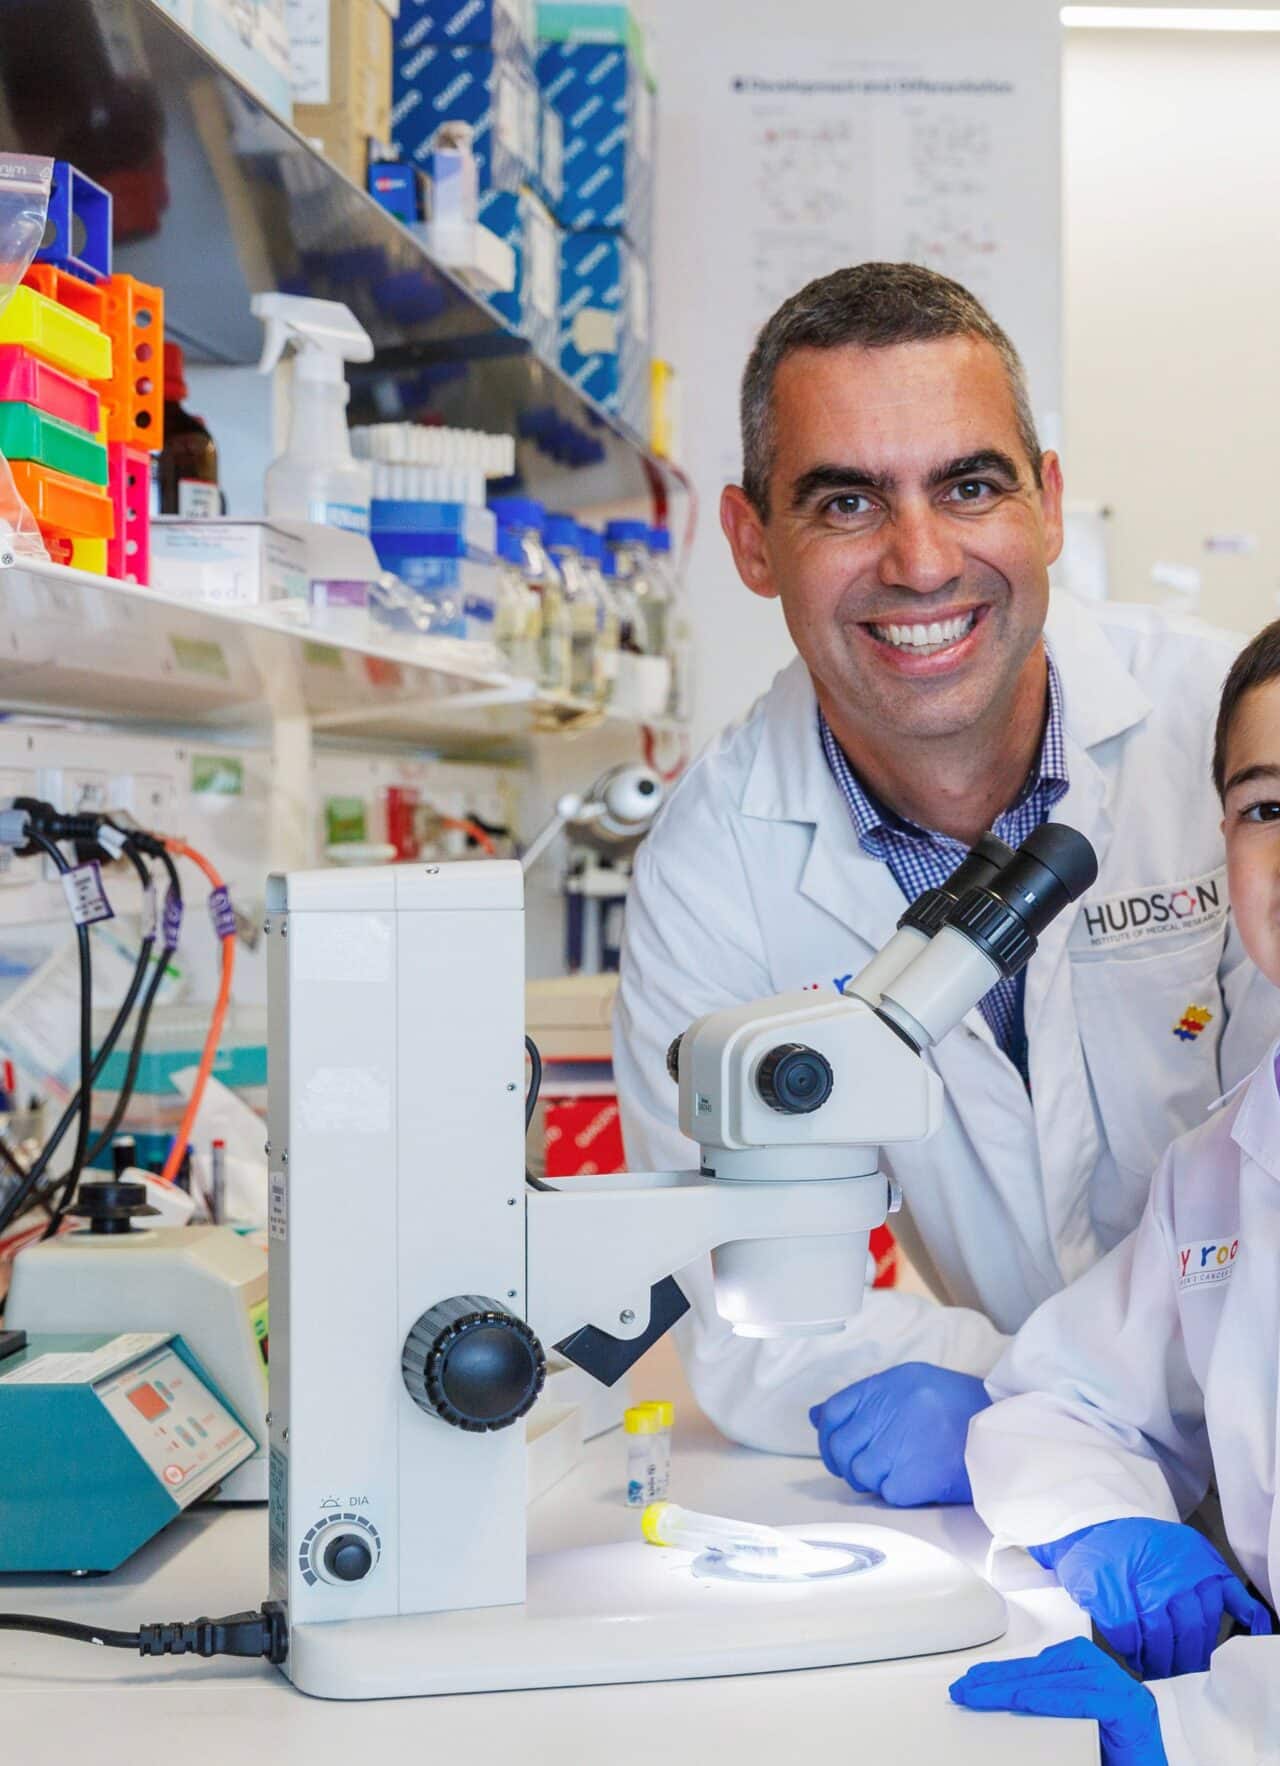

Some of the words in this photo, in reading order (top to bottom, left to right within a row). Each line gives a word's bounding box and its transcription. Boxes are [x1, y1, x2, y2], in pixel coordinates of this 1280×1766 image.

[1084, 880, 1219, 936] HUDSON
[1146, 922, 1180, 935] MEDICAL
[1201, 1239, 1239, 1267] roo
[349, 1495, 370, 1507] DIA
